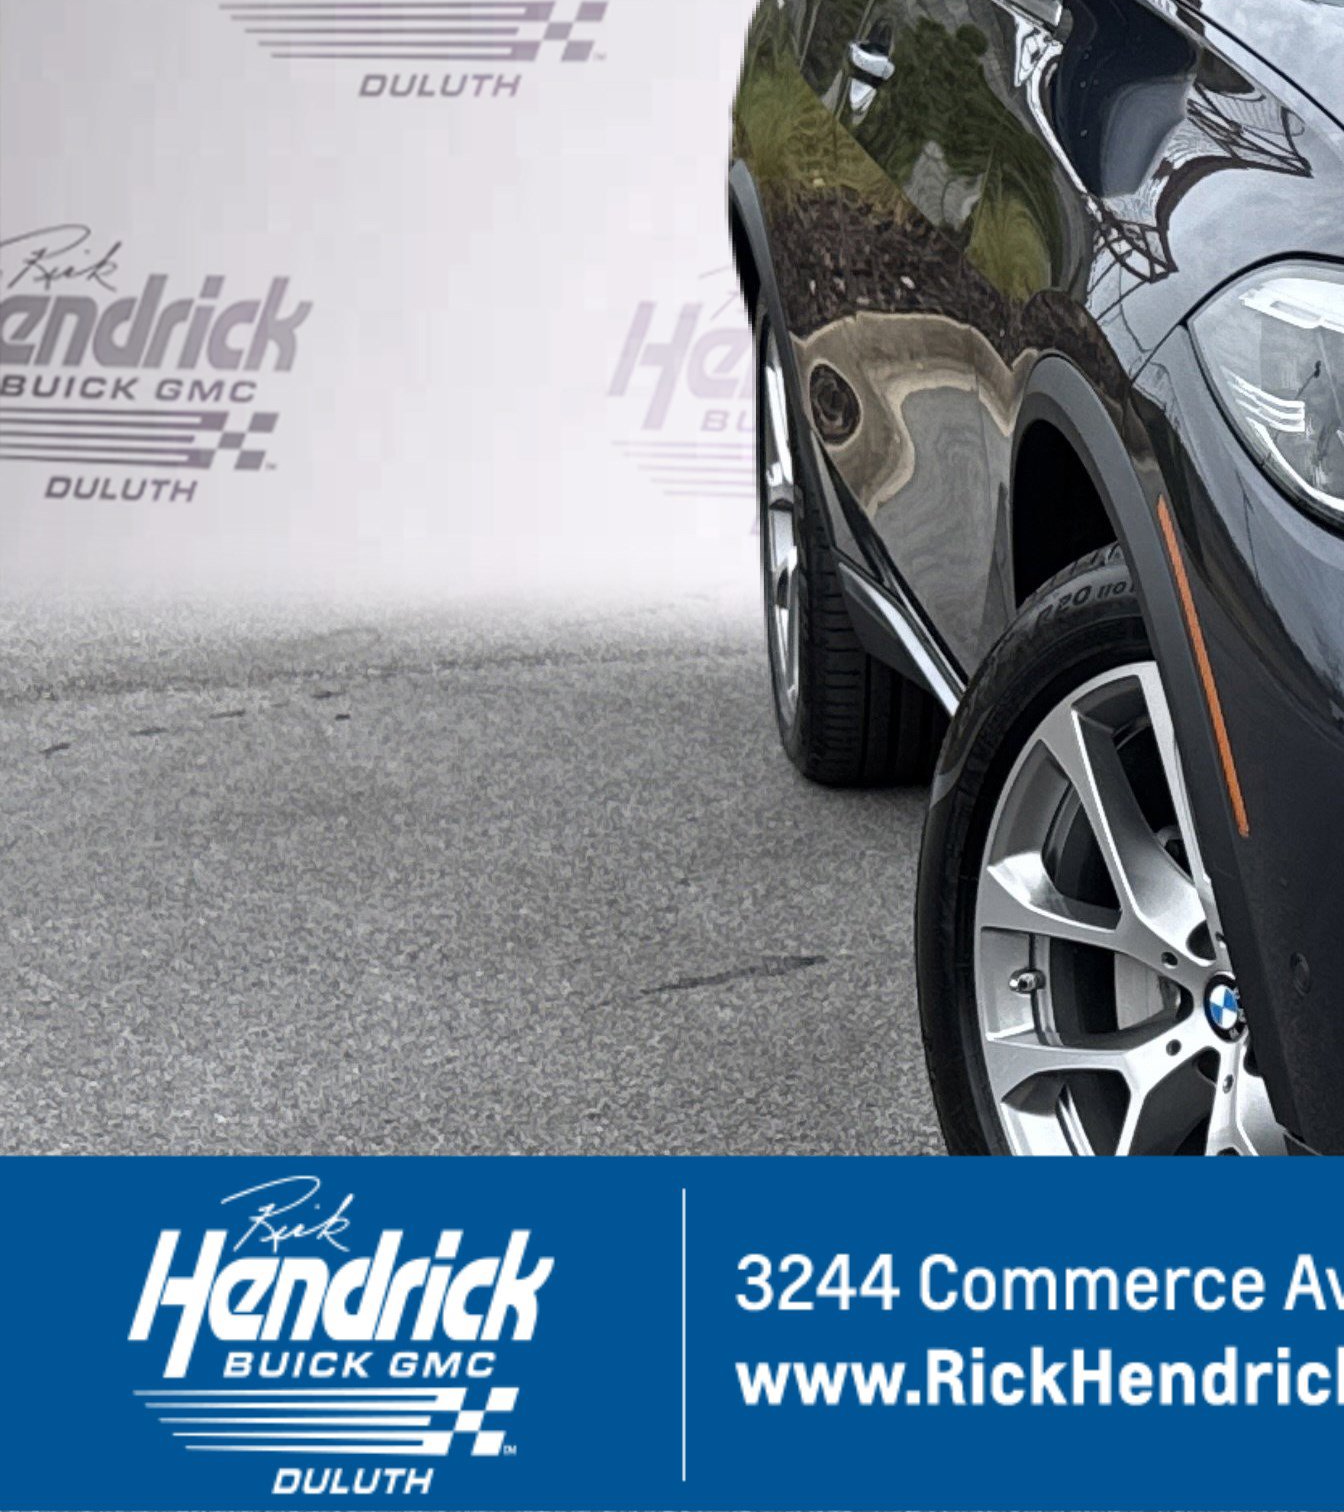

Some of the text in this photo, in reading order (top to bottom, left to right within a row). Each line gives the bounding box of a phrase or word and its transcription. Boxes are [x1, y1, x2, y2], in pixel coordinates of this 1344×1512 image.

[358, 74, 521, 97] DULUTH
[0, 274, 313, 372] endrick
[0, 374, 256, 403] BUICK GMC
[44, 475, 197, 502] DULUTH
